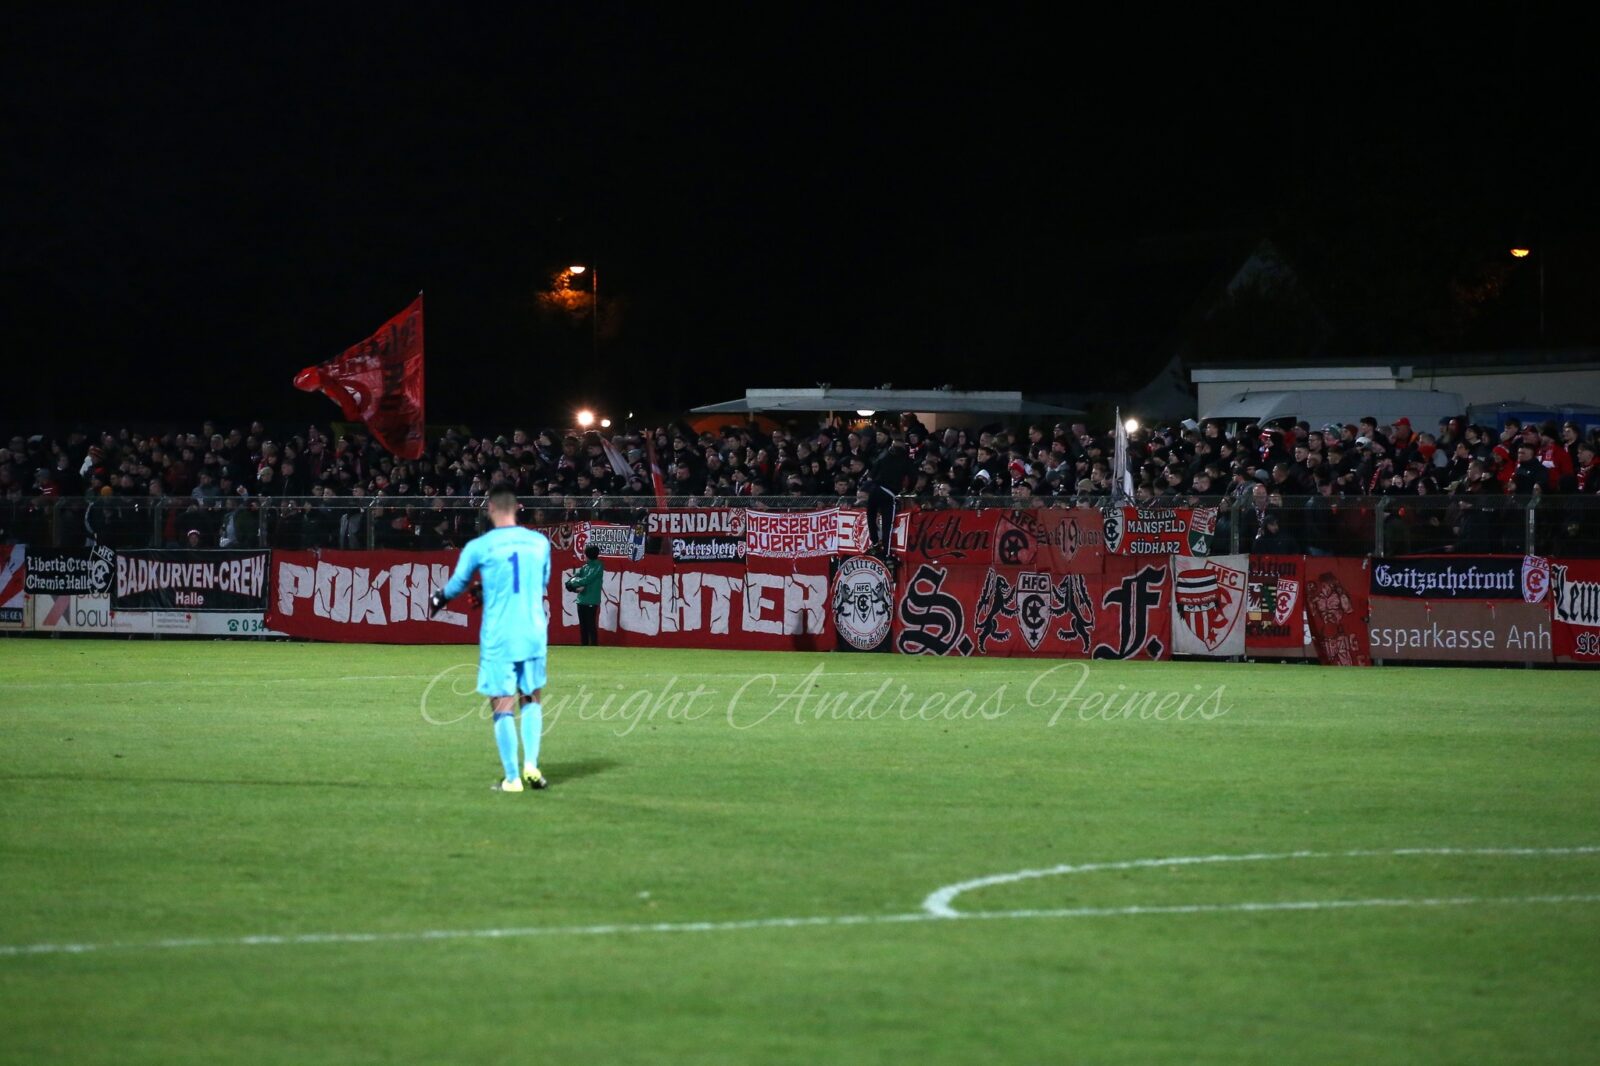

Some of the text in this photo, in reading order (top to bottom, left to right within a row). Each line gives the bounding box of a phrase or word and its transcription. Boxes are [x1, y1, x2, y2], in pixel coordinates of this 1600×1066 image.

[648, 511, 732, 533] STENDAL
[1127, 520, 1186, 533] MANSFELD
[590, 528, 629, 543] SEKTION
[673, 538, 736, 560] Petersberg
[1130, 539, 1180, 554] SÜDHARZ
[507, 552, 520, 594] 1
[842, 560, 884, 576] Ultras
[26, 574, 65, 591] Chemie
[116, 554, 266, 598] BADKURVEN-CREW
[1022, 575, 1048, 590] HFC
[856, 584, 870, 593] HFC
[1278, 581, 1295, 591] HFC
[175, 591, 205, 606] Halle
[1370, 622, 1496, 654] ssparkasse
[1506, 623, 1551, 650] Anh
